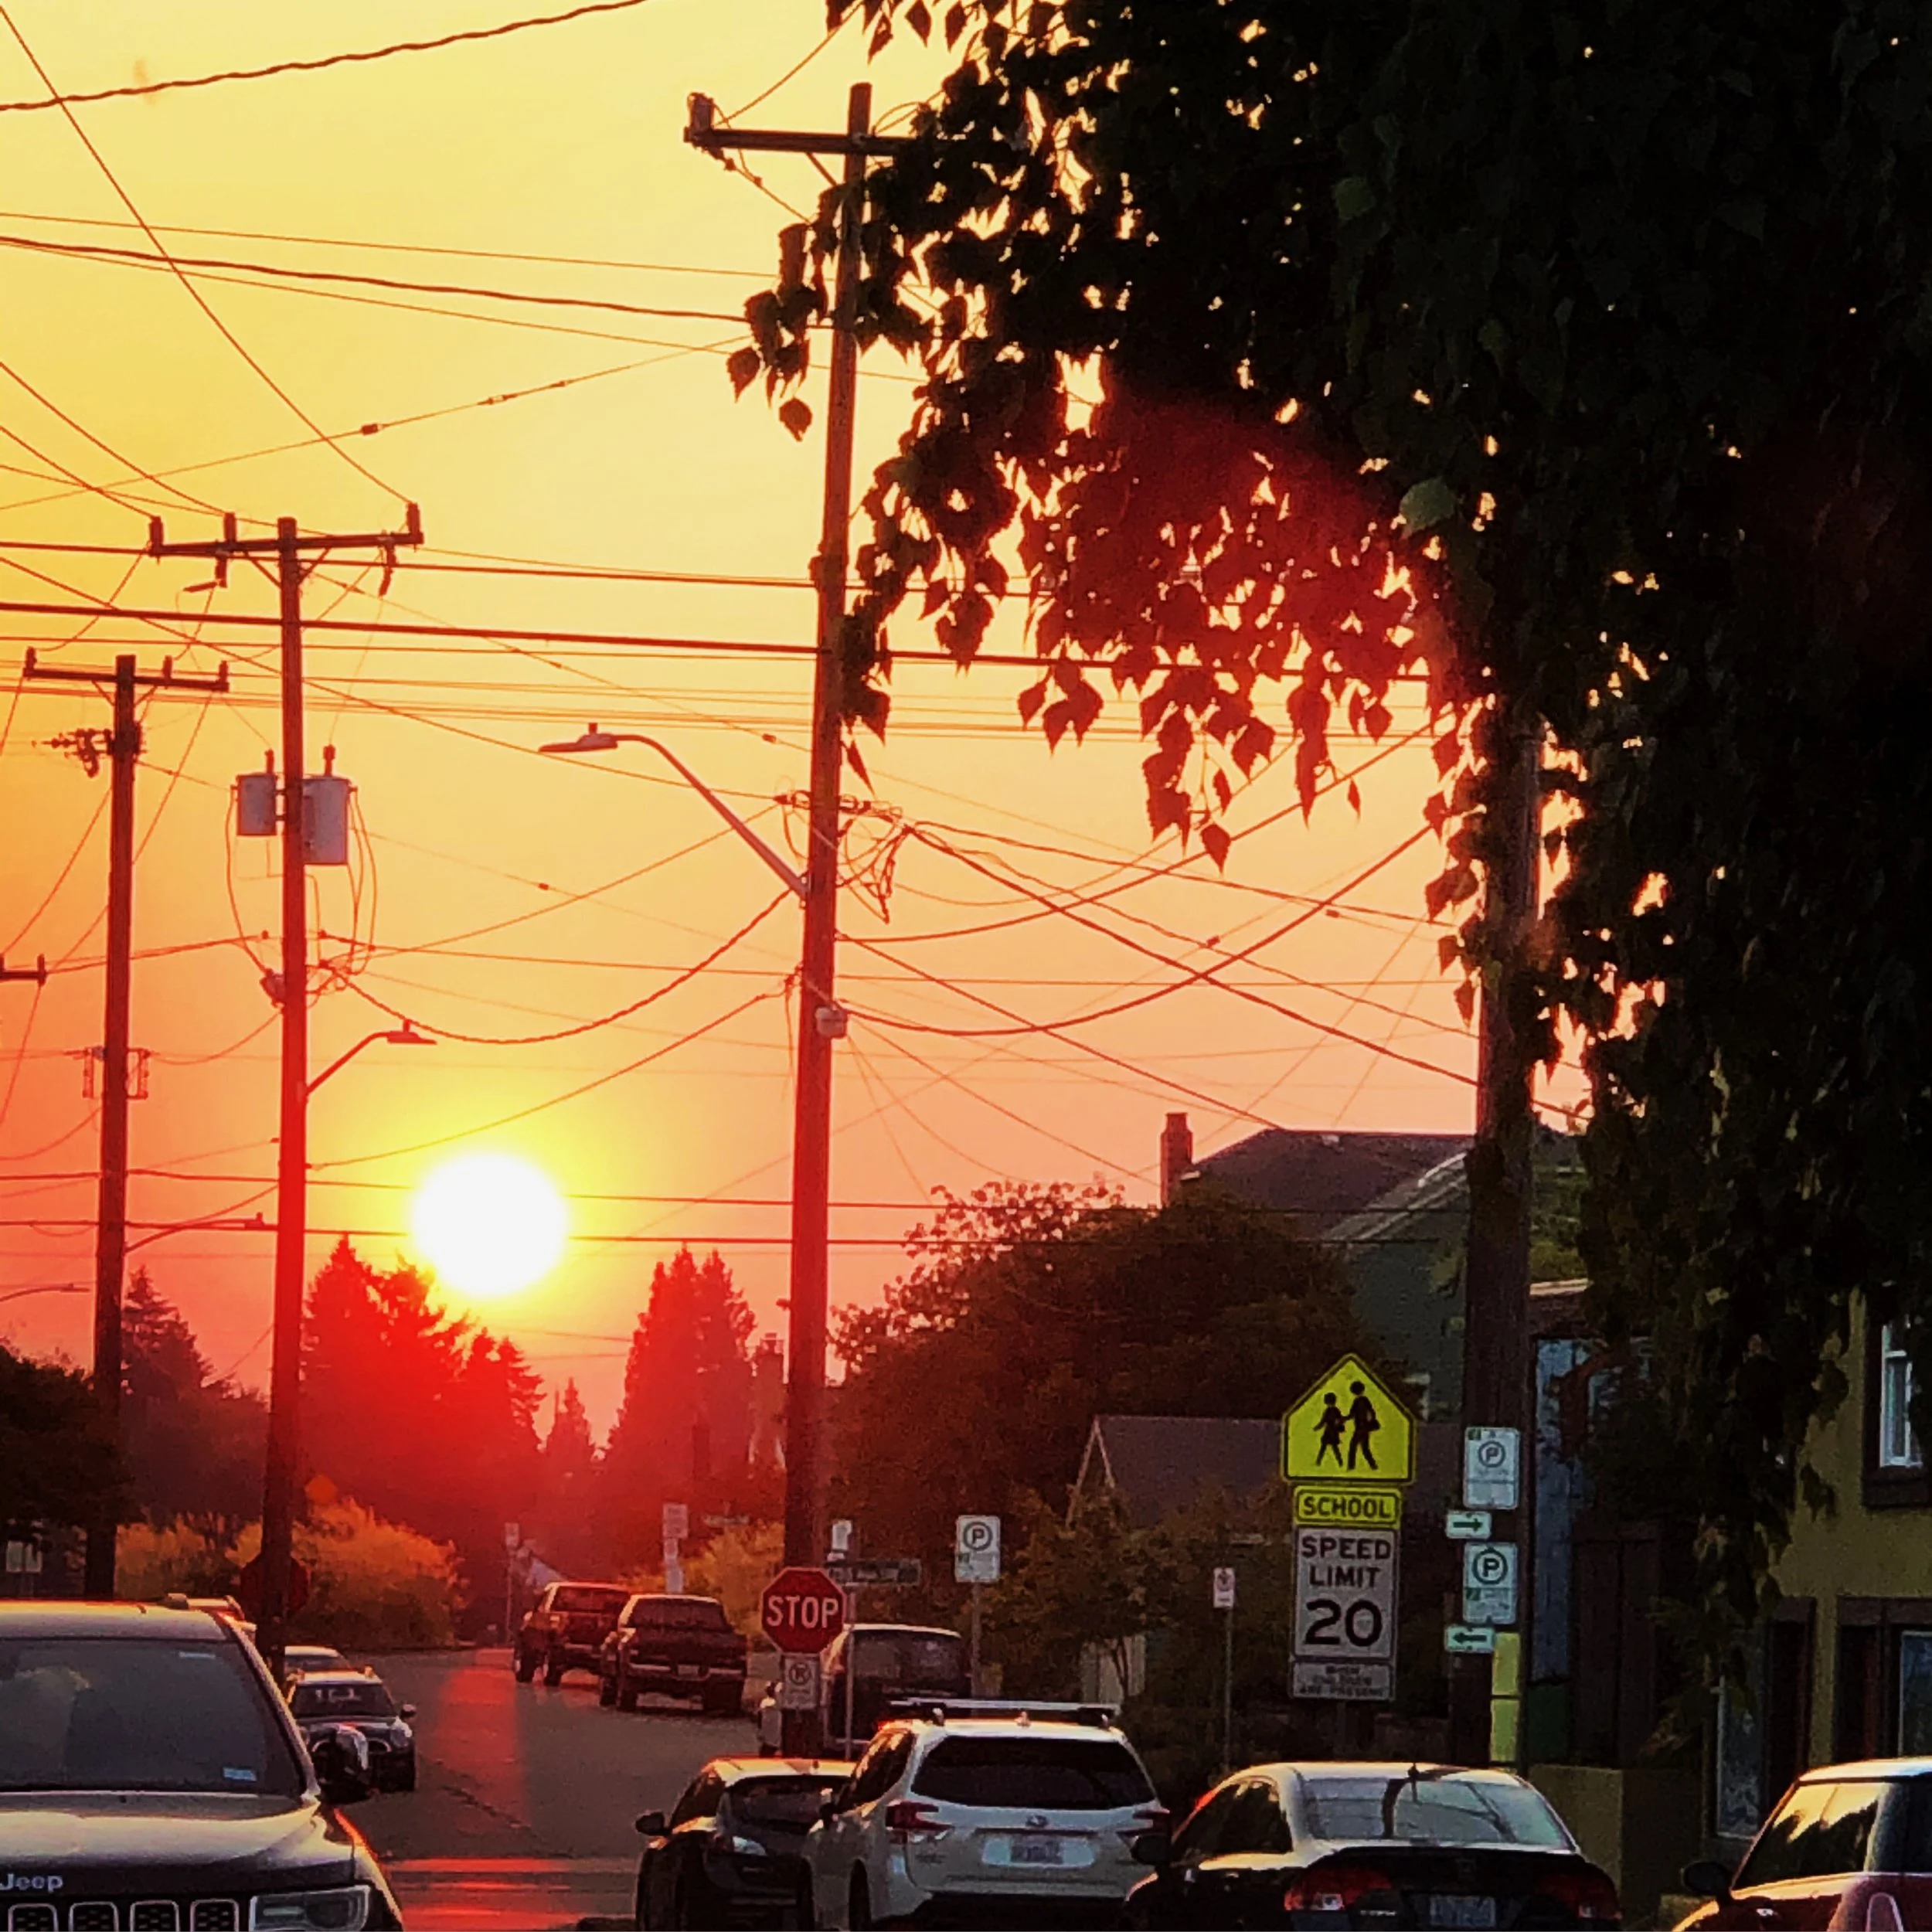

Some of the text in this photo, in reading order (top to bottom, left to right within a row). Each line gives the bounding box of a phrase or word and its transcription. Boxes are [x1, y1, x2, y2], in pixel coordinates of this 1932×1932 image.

[1485, 1447, 1499, 1463] P
[1303, 1496, 1392, 1519] SCHOOL
[971, 1528, 985, 1544] P
[1301, 1535, 1392, 1560] SPEED
[1309, 1565, 1381, 1588] LIMIT
[1481, 1557, 1500, 1577] P
[767, 1594, 838, 1629] STOP
[1304, 1598, 1383, 1647] 20
[0, 1872, 63, 1893] Jeep
